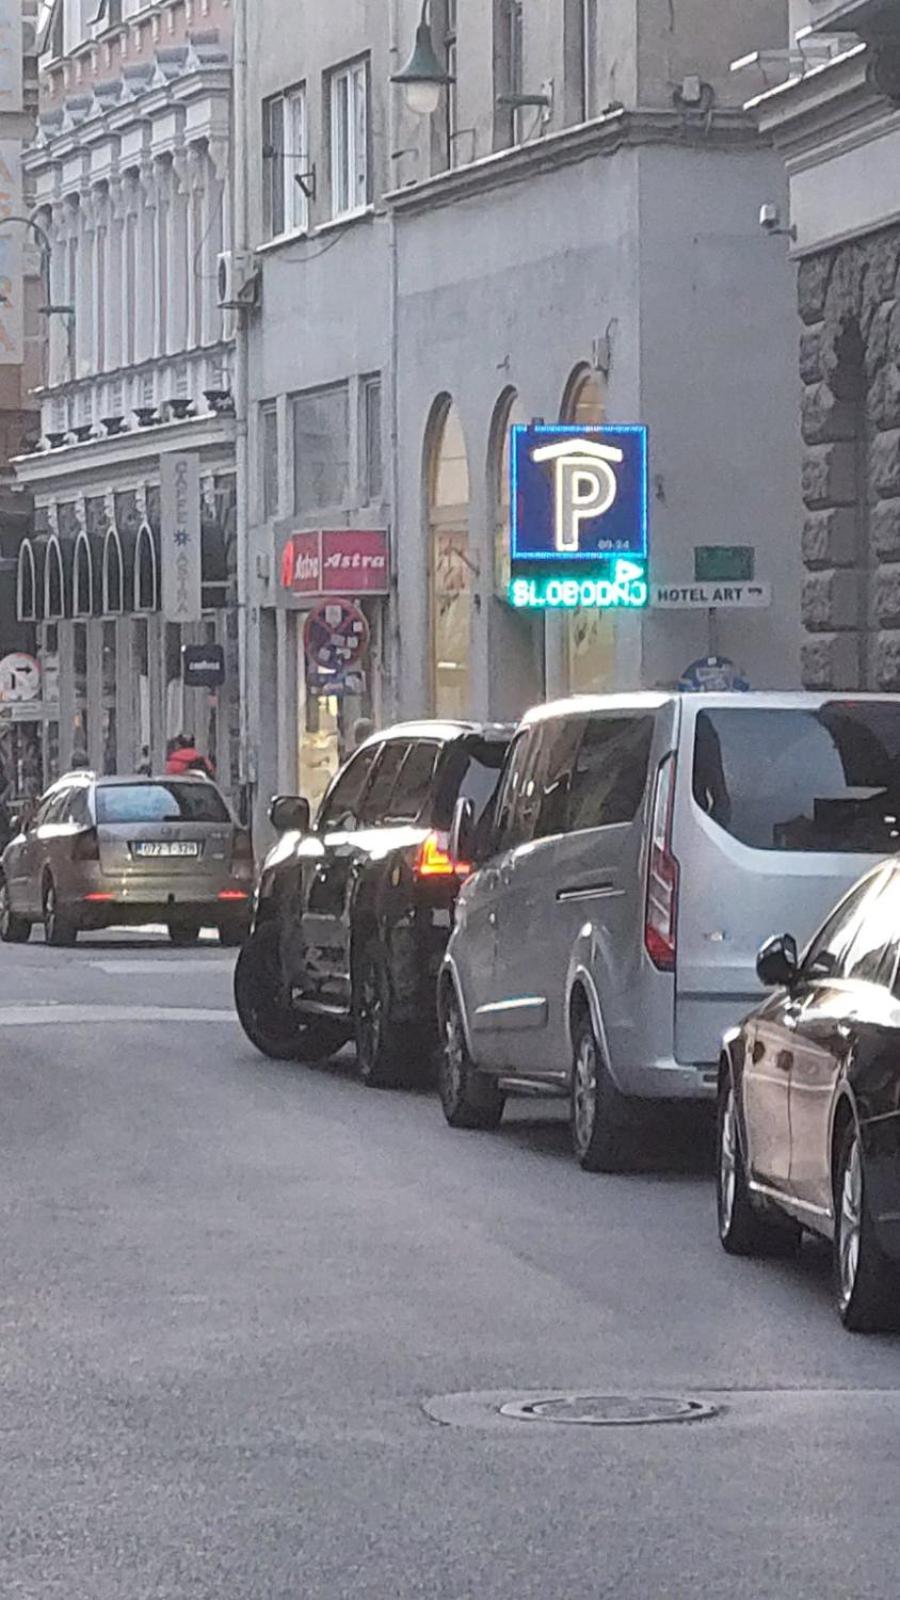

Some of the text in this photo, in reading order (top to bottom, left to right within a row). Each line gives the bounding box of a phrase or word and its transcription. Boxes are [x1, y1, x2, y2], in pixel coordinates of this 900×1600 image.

[556, 455, 617, 552] P
[323, 552, 385, 568] Astra
[657, 587, 744, 602] HOTEL ART
